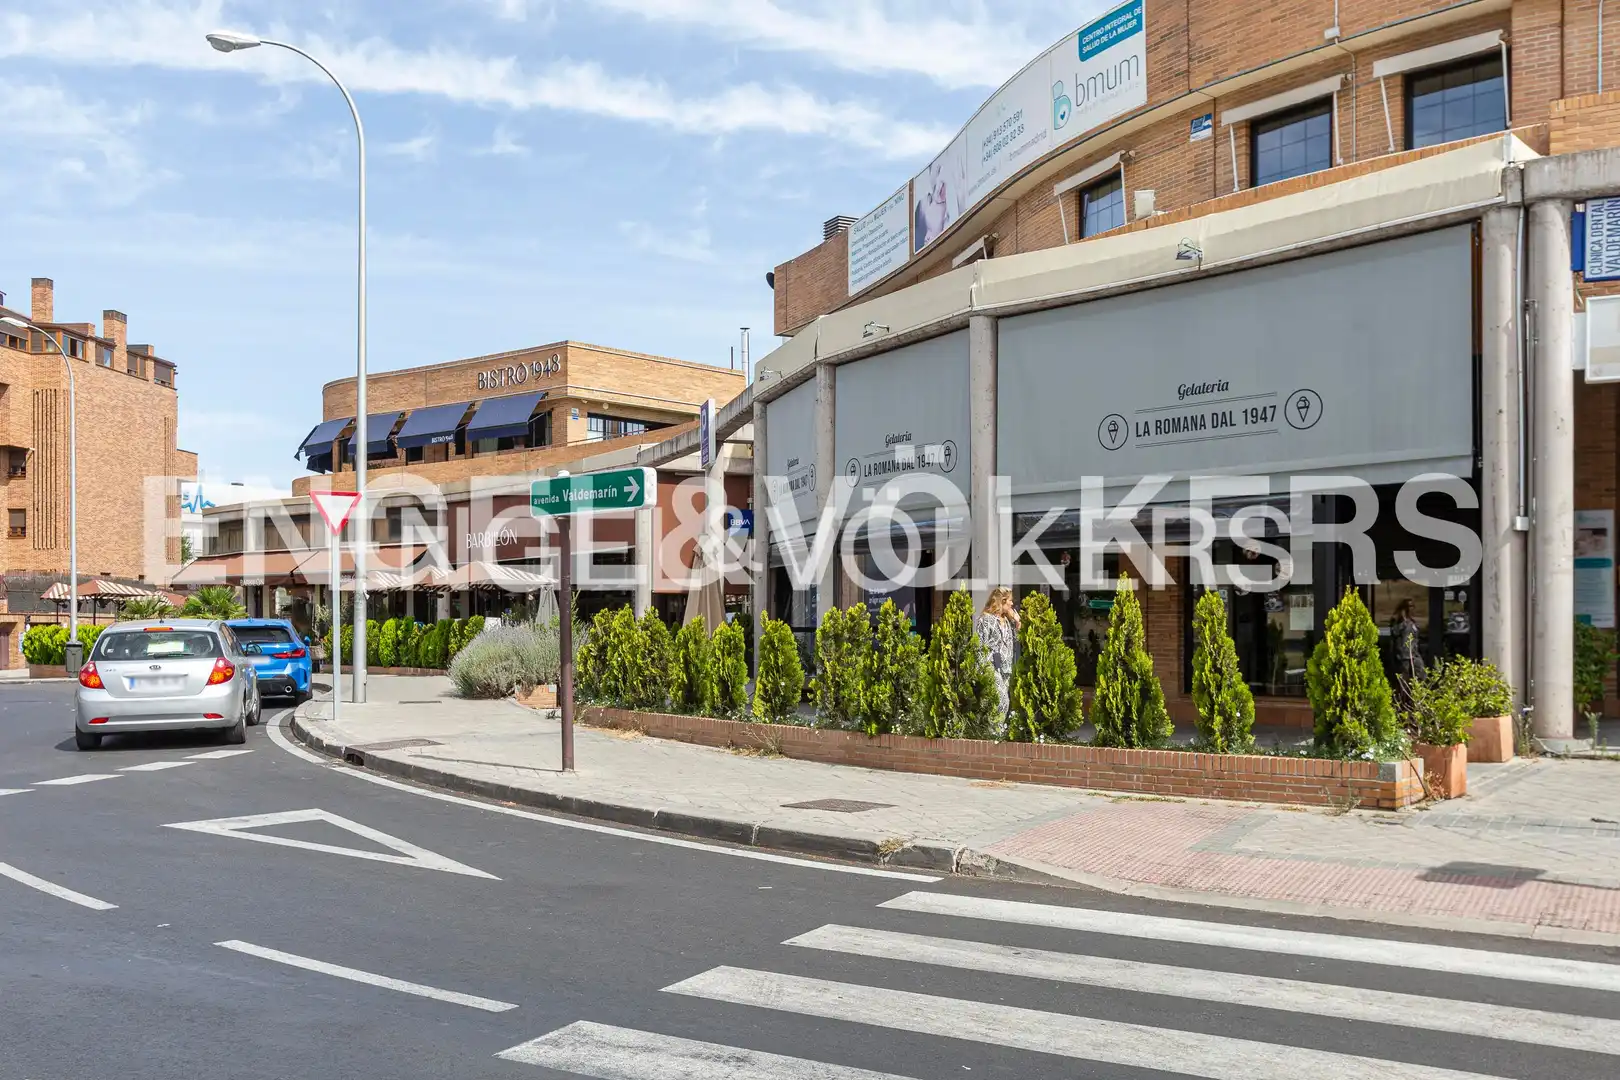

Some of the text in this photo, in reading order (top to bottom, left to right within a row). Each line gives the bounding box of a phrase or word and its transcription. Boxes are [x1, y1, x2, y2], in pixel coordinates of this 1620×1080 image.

[1082, 5, 1142, 44] CENTRO INTEGRAL DE
[1082, 18, 1138, 54] SALUD DE LA MUJER
[1075, 54, 1139, 107] bmum
[1588, 203, 1605, 276] CLÍNICA DENTAL
[530, 353, 561, 381] 1948
[1177, 379, 1229, 400] Gelateria
[1135, 405, 1277, 438] LA ROMANA DAL 1947
[885, 431, 912, 448] Gelateria
[864, 452, 935, 478] LA ROMANA DAL 1947
[534, 484, 618, 505] avenida Valdemarín
[730, 518, 751, 526] BBVA
